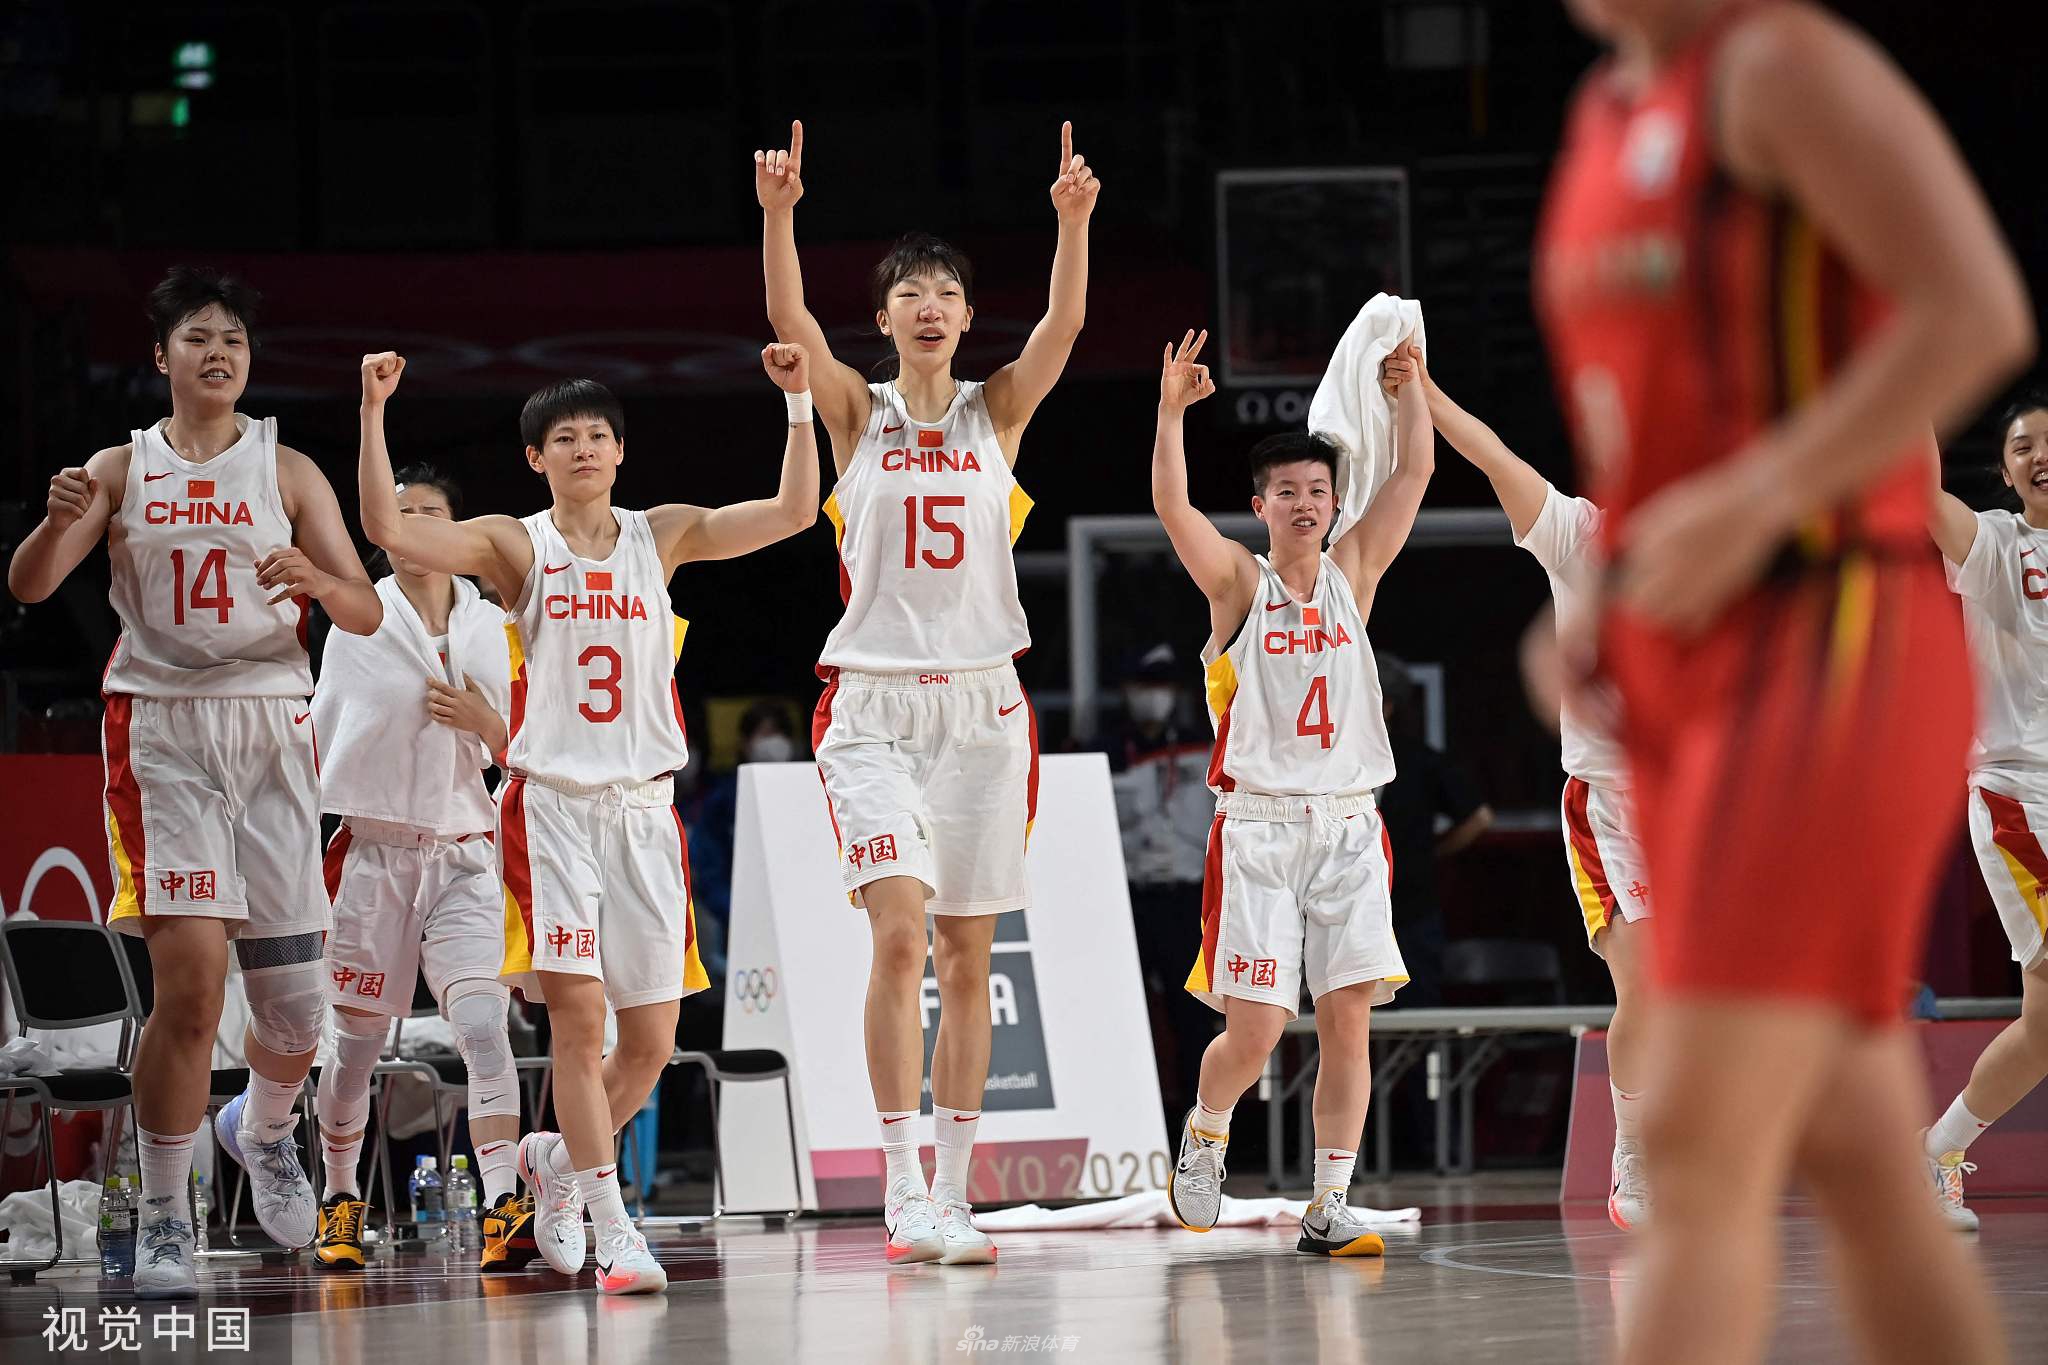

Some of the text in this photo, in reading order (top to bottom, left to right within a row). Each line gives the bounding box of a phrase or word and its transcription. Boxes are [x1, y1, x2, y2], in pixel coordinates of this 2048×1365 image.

[882, 448, 981, 472] CHINA
[145, 501, 253, 526] CHINA
[904, 496, 965, 569] 15
[171, 549, 233, 625] 14
[545, 594, 647, 620] CHINA
[1264, 623, 1352, 654] CHINA
[578, 646, 622, 723] 3
[919, 674, 949, 685] CHN
[1297, 676, 1334, 749] 4
[848, 834, 897, 871] 中国
[160, 870, 216, 901] 中国
[547, 925, 595, 959] 中国
[333, 966, 384, 998] 中国
[1228, 954, 1276, 987] 中国
[919, 973, 1019, 1029] FA
[922, 1151, 1169, 1201] KYO 2020
